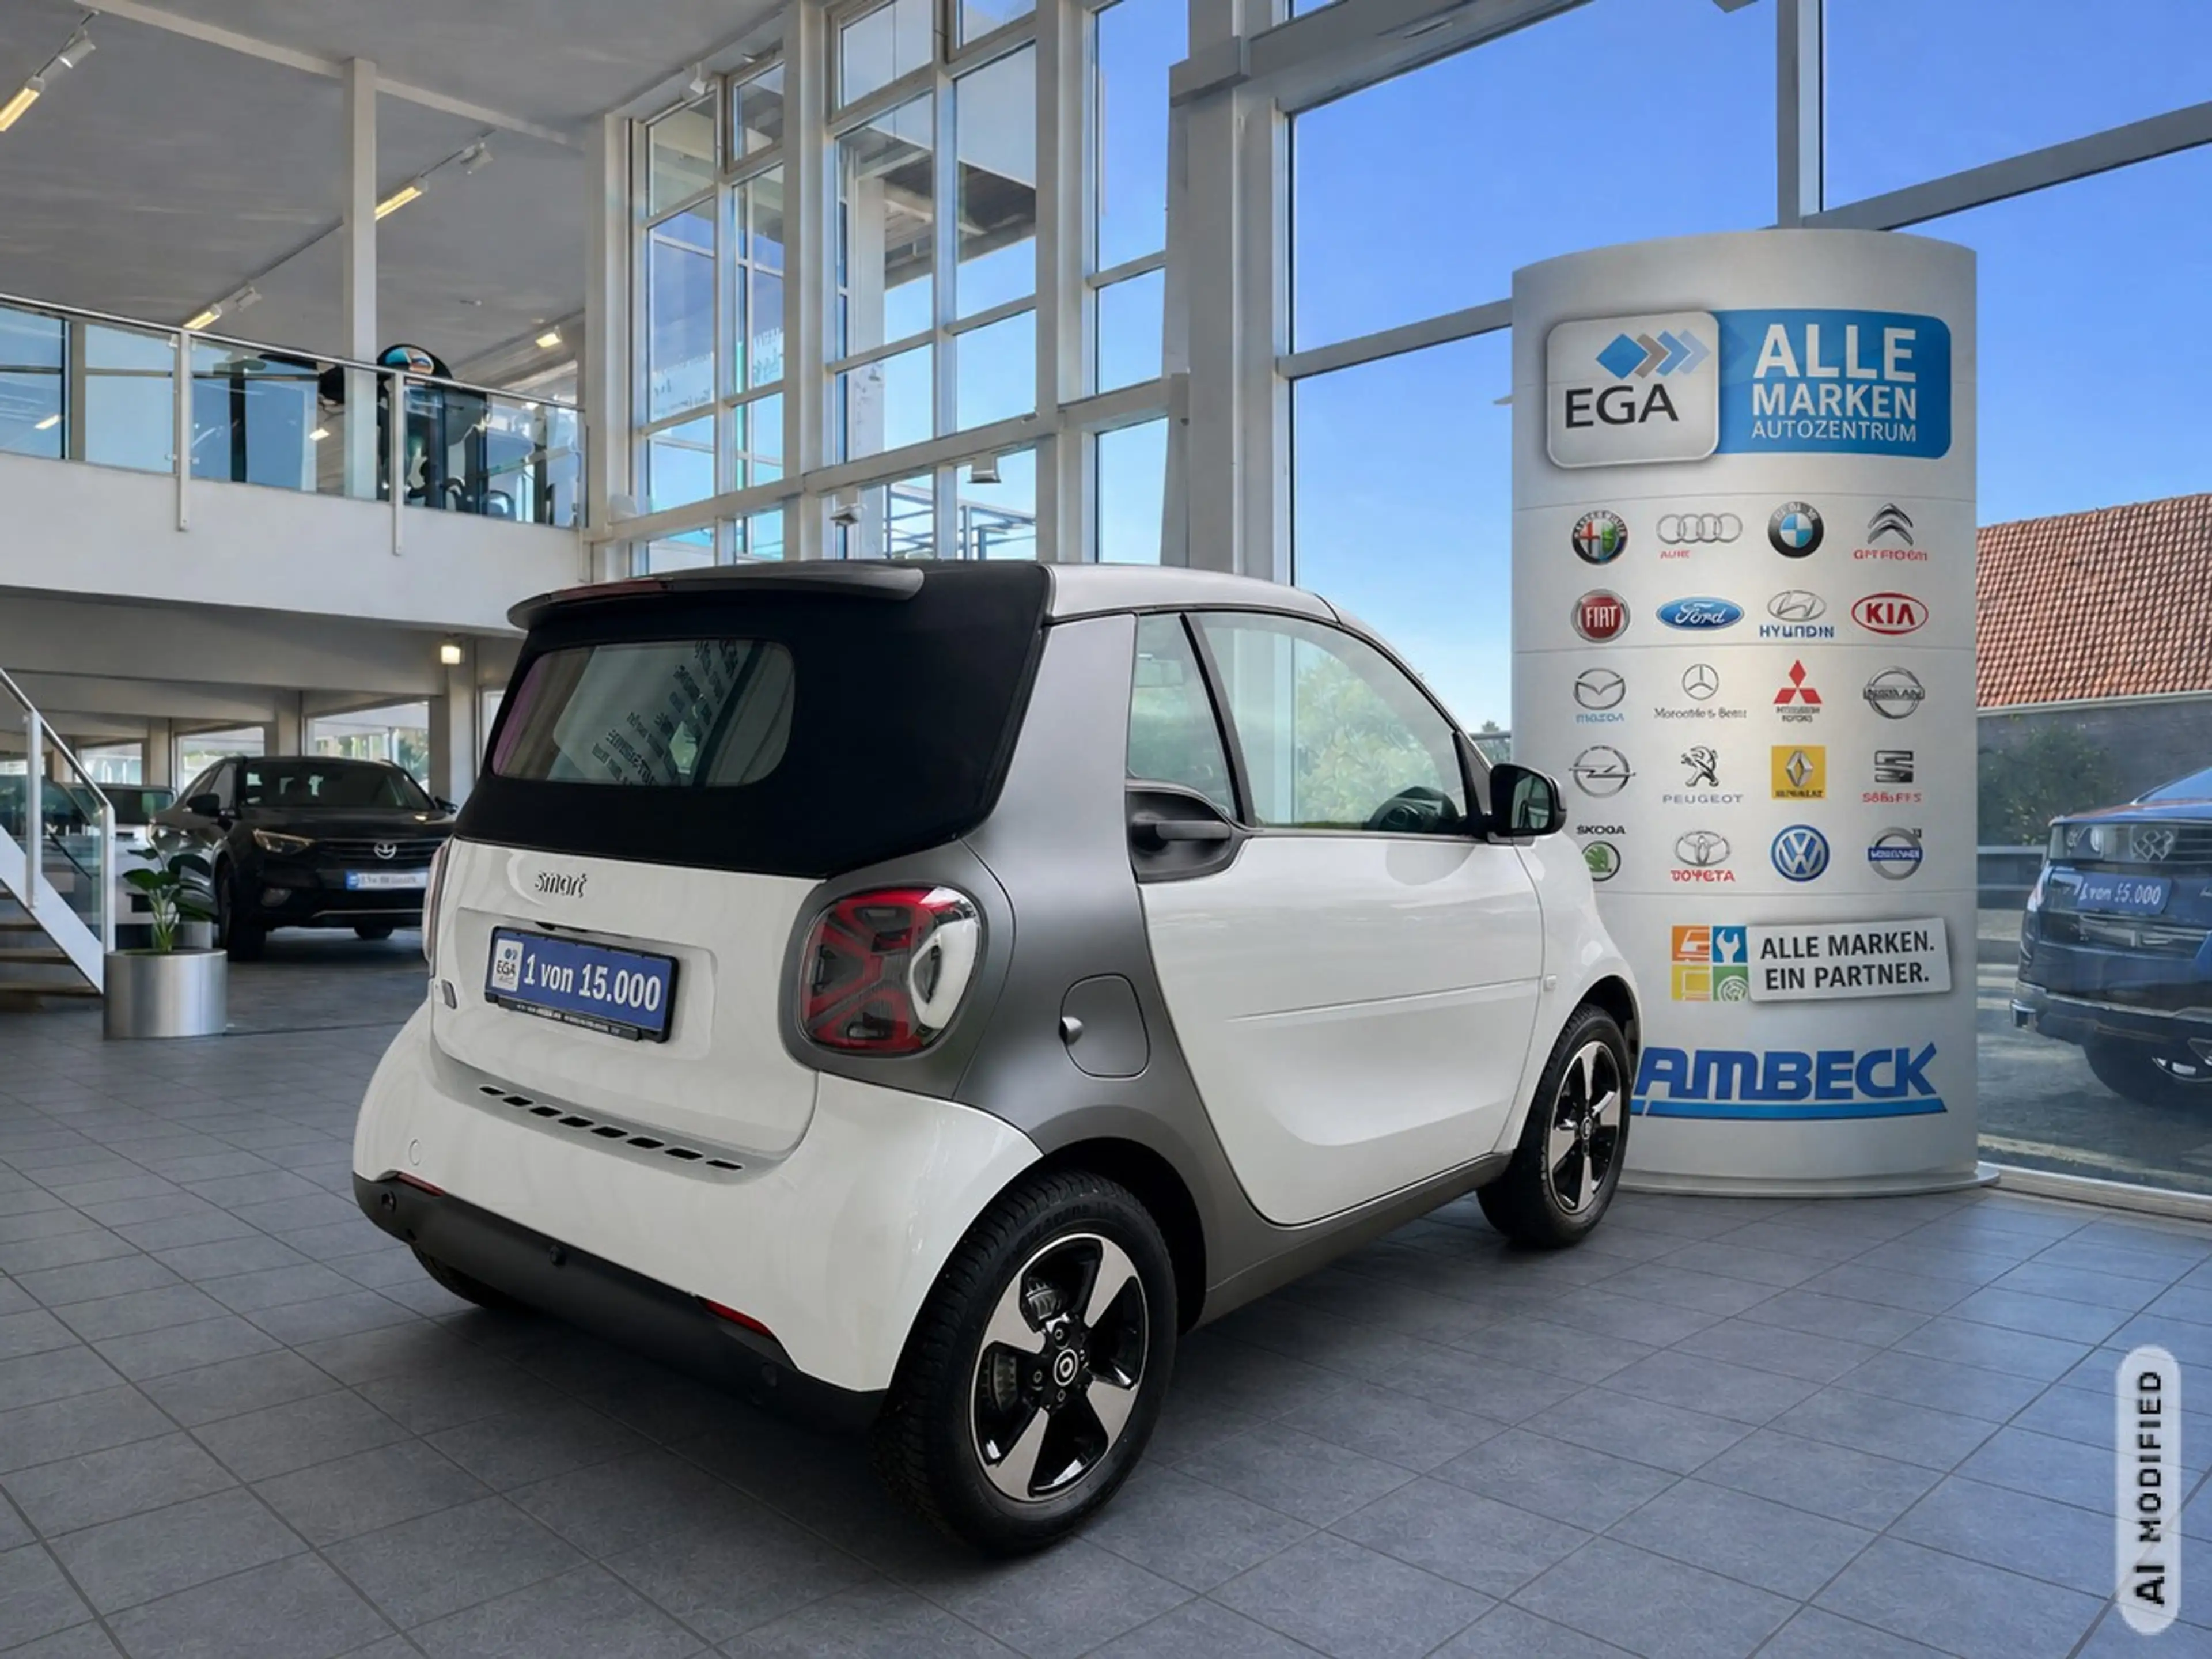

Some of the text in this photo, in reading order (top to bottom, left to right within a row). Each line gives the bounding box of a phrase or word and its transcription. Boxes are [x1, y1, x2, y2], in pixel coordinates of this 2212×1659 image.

[1753, 324, 1916, 382] ALLE
[1565, 382, 1679, 429] EGA
[1752, 382, 1916, 420] MARKEN
[1751, 419, 1917, 442] AUTOZENTRUM
[1586, 605, 1618, 628] FIAT
[1675, 603, 1725, 624] Ford
[1865, 602, 1915, 626] KIA
[1662, 794, 1744, 804] PEUGEOT
[1760, 930, 1935, 960] ALLE MARKEN.
[523, 953, 662, 1012] 1 von 15.000
[1766, 961, 1930, 990] EIN PARTNER.
[1633, 1041, 1937, 1100] AMBECK
